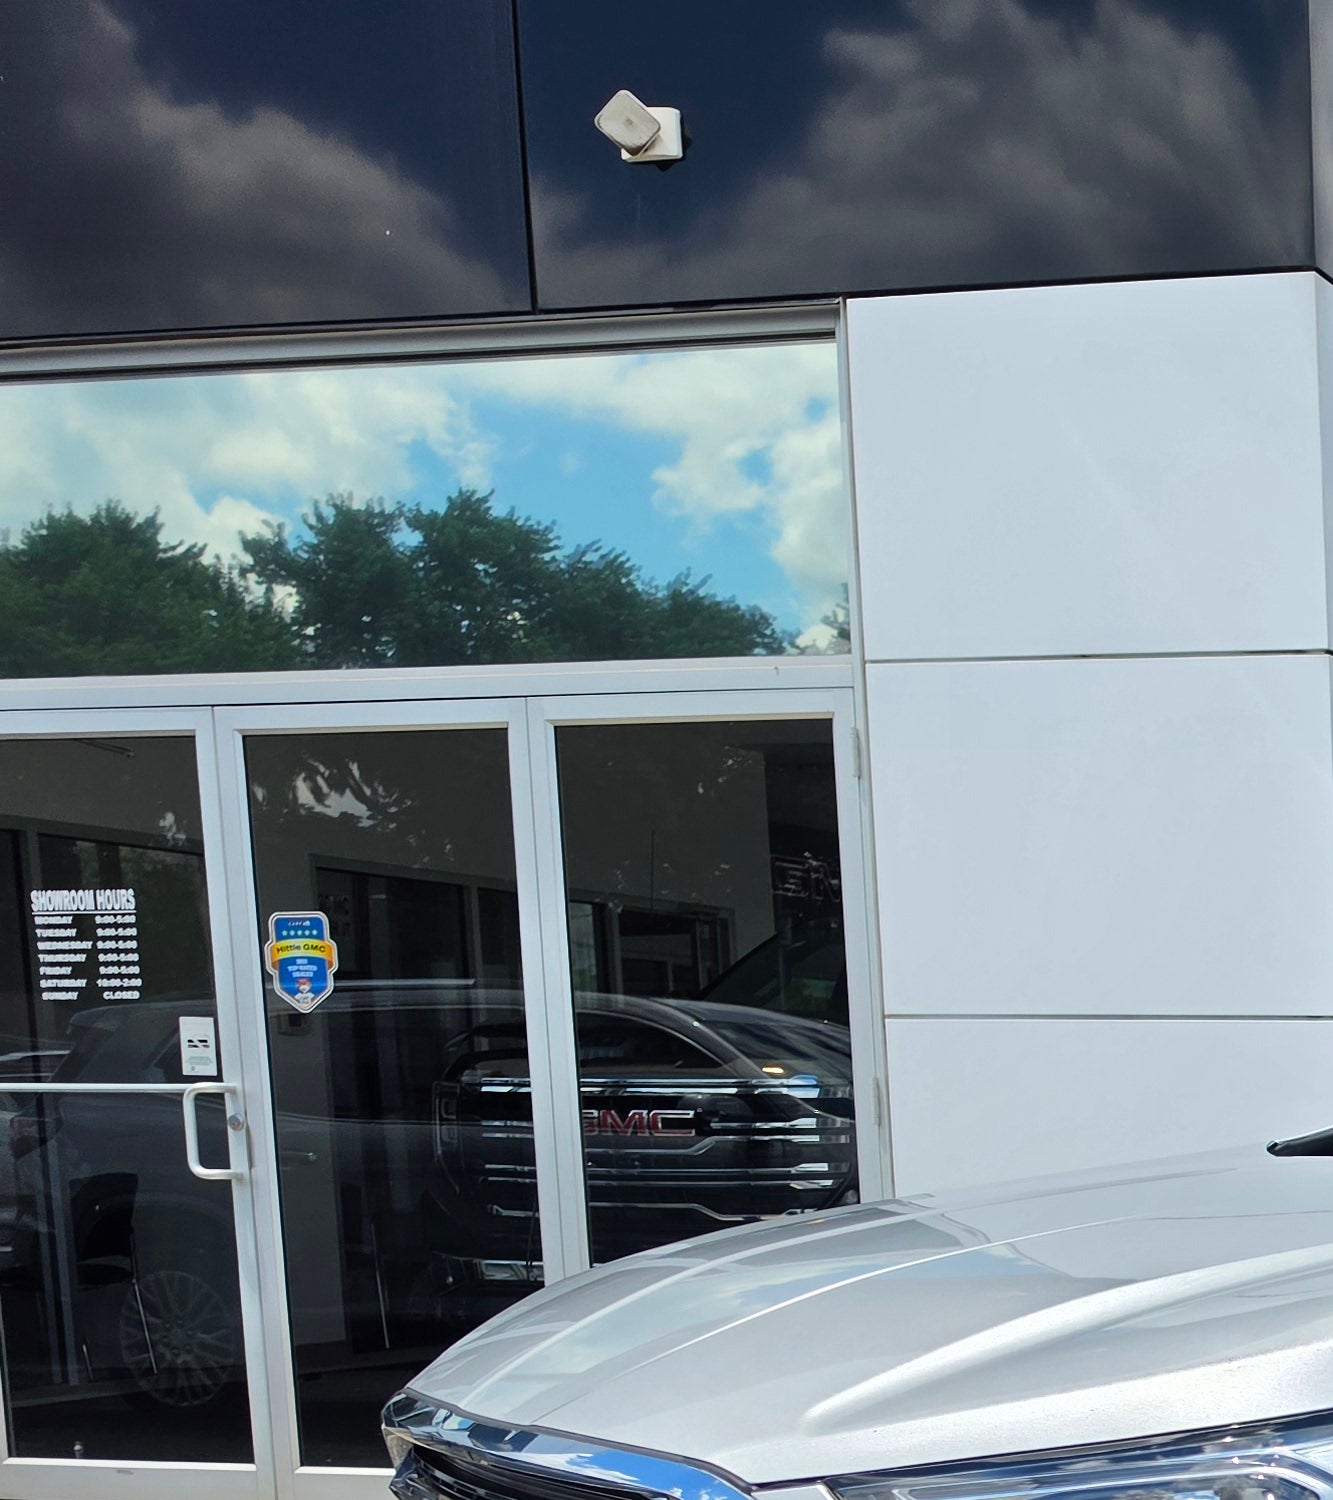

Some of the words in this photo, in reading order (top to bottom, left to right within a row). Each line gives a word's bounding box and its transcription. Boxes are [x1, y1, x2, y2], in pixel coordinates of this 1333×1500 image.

[30, 889, 95, 911] SHOWROOM
[95, 888, 136, 910] HOURS
[34, 915, 73, 925] MONDAY
[35, 928, 77, 937] TUESDAY
[36, 941, 93, 950] WEDNESDAY
[276, 944, 301, 954] Hittle
[302, 943, 326, 953] GMC
[37, 953, 87, 963] THURSDAY
[39, 966, 72, 975] FRIDAY
[39, 979, 87, 988] SATURDAY
[41, 991, 79, 1000] SUNDAY
[102, 990, 140, 1000] CLOSED
